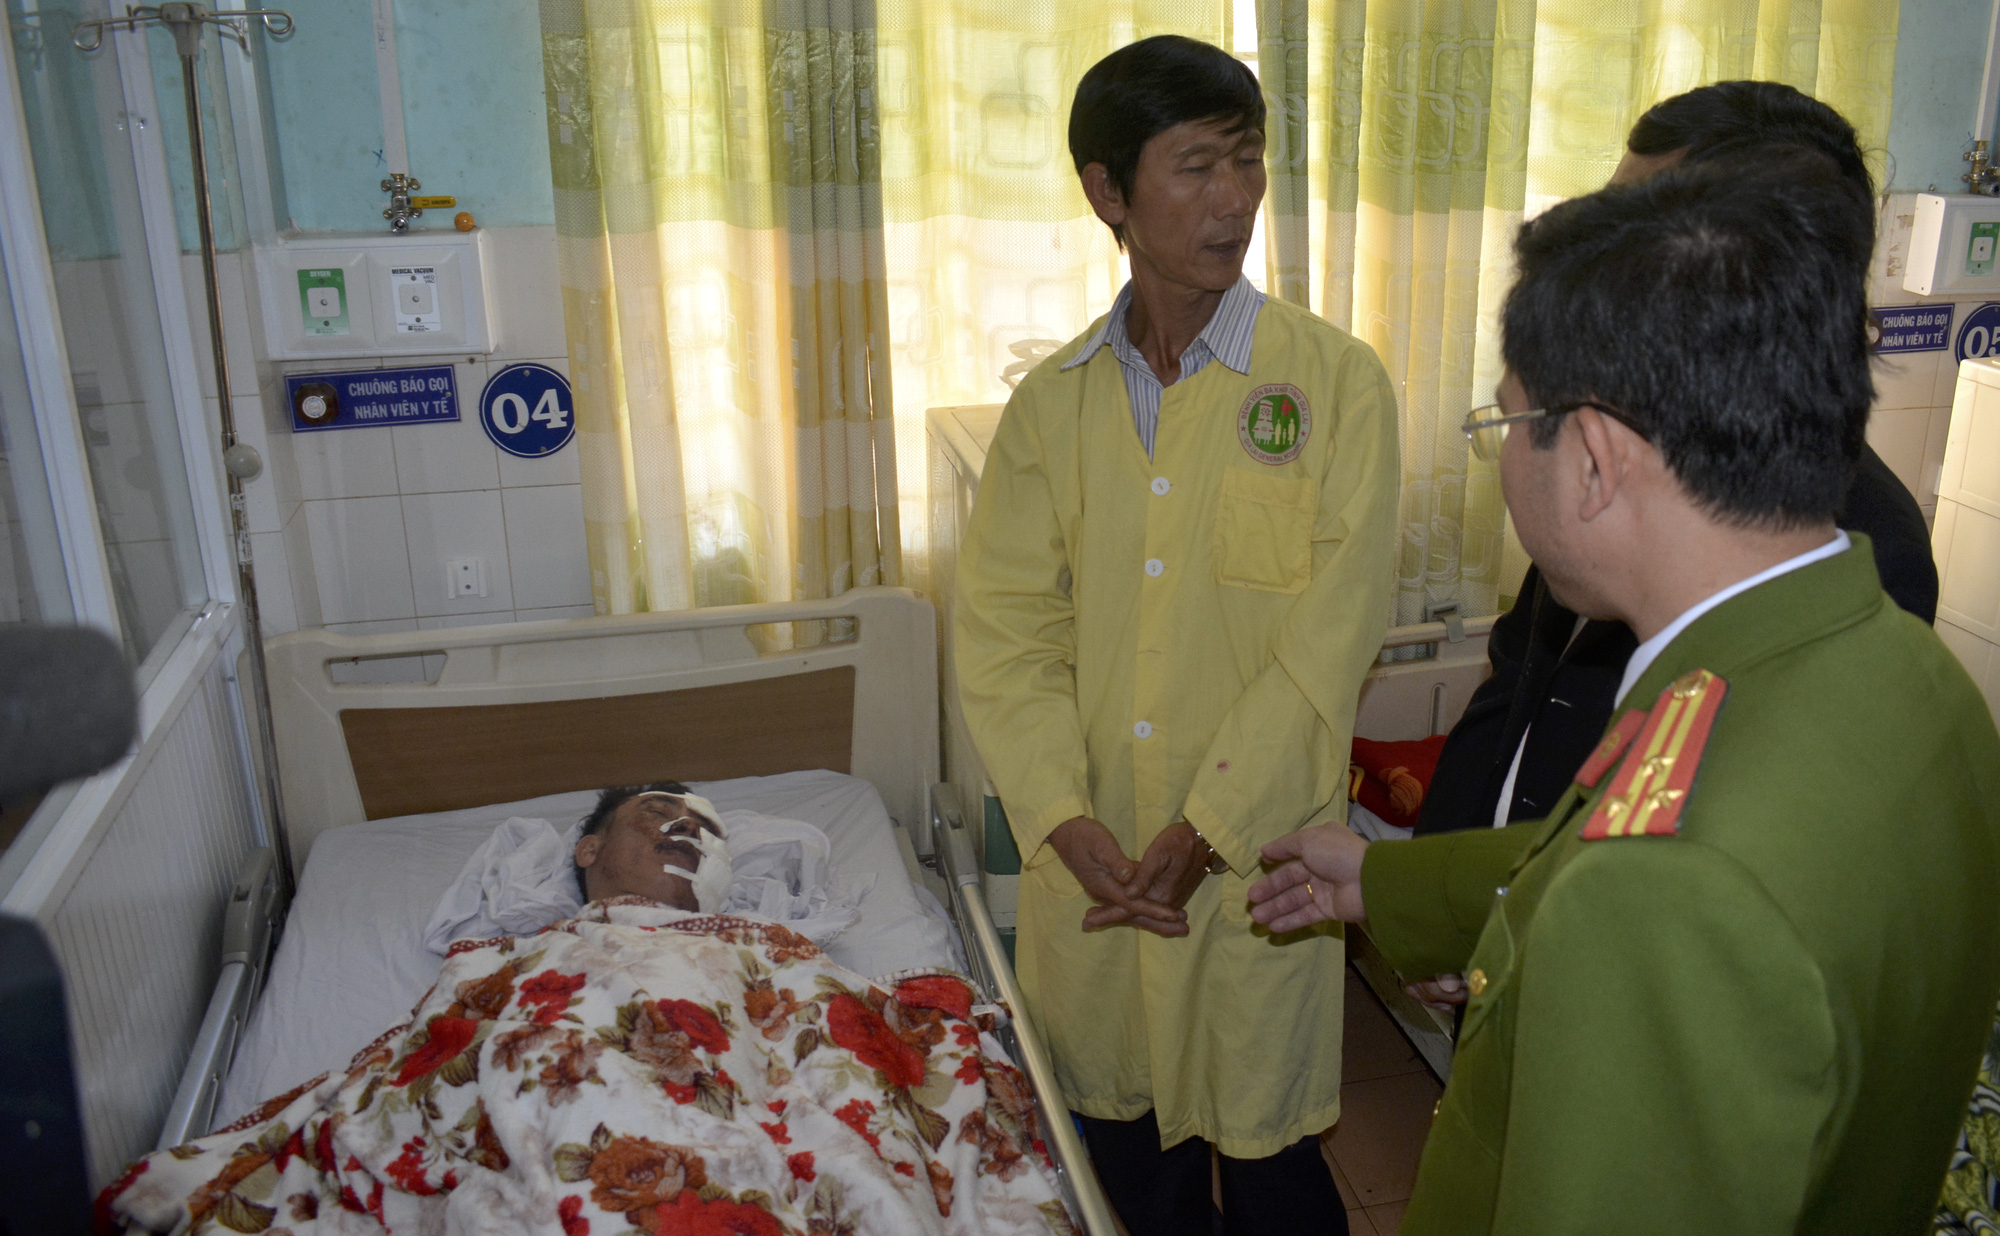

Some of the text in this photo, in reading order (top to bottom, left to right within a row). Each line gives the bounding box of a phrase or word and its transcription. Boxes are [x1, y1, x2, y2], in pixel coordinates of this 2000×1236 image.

[414, 266, 434, 274] VACUUM
[1882, 312, 1948, 328] CHUÔNG BÁO GỌI
[1881, 330, 1944, 347] NHÂN VIÊN Y TẾ
[349, 375, 449, 397] CHUÔNG BÁO GỌI
[354, 397, 449, 420] NHÂN VIÊN Y TẾ
[491, 388, 569, 434] 04
